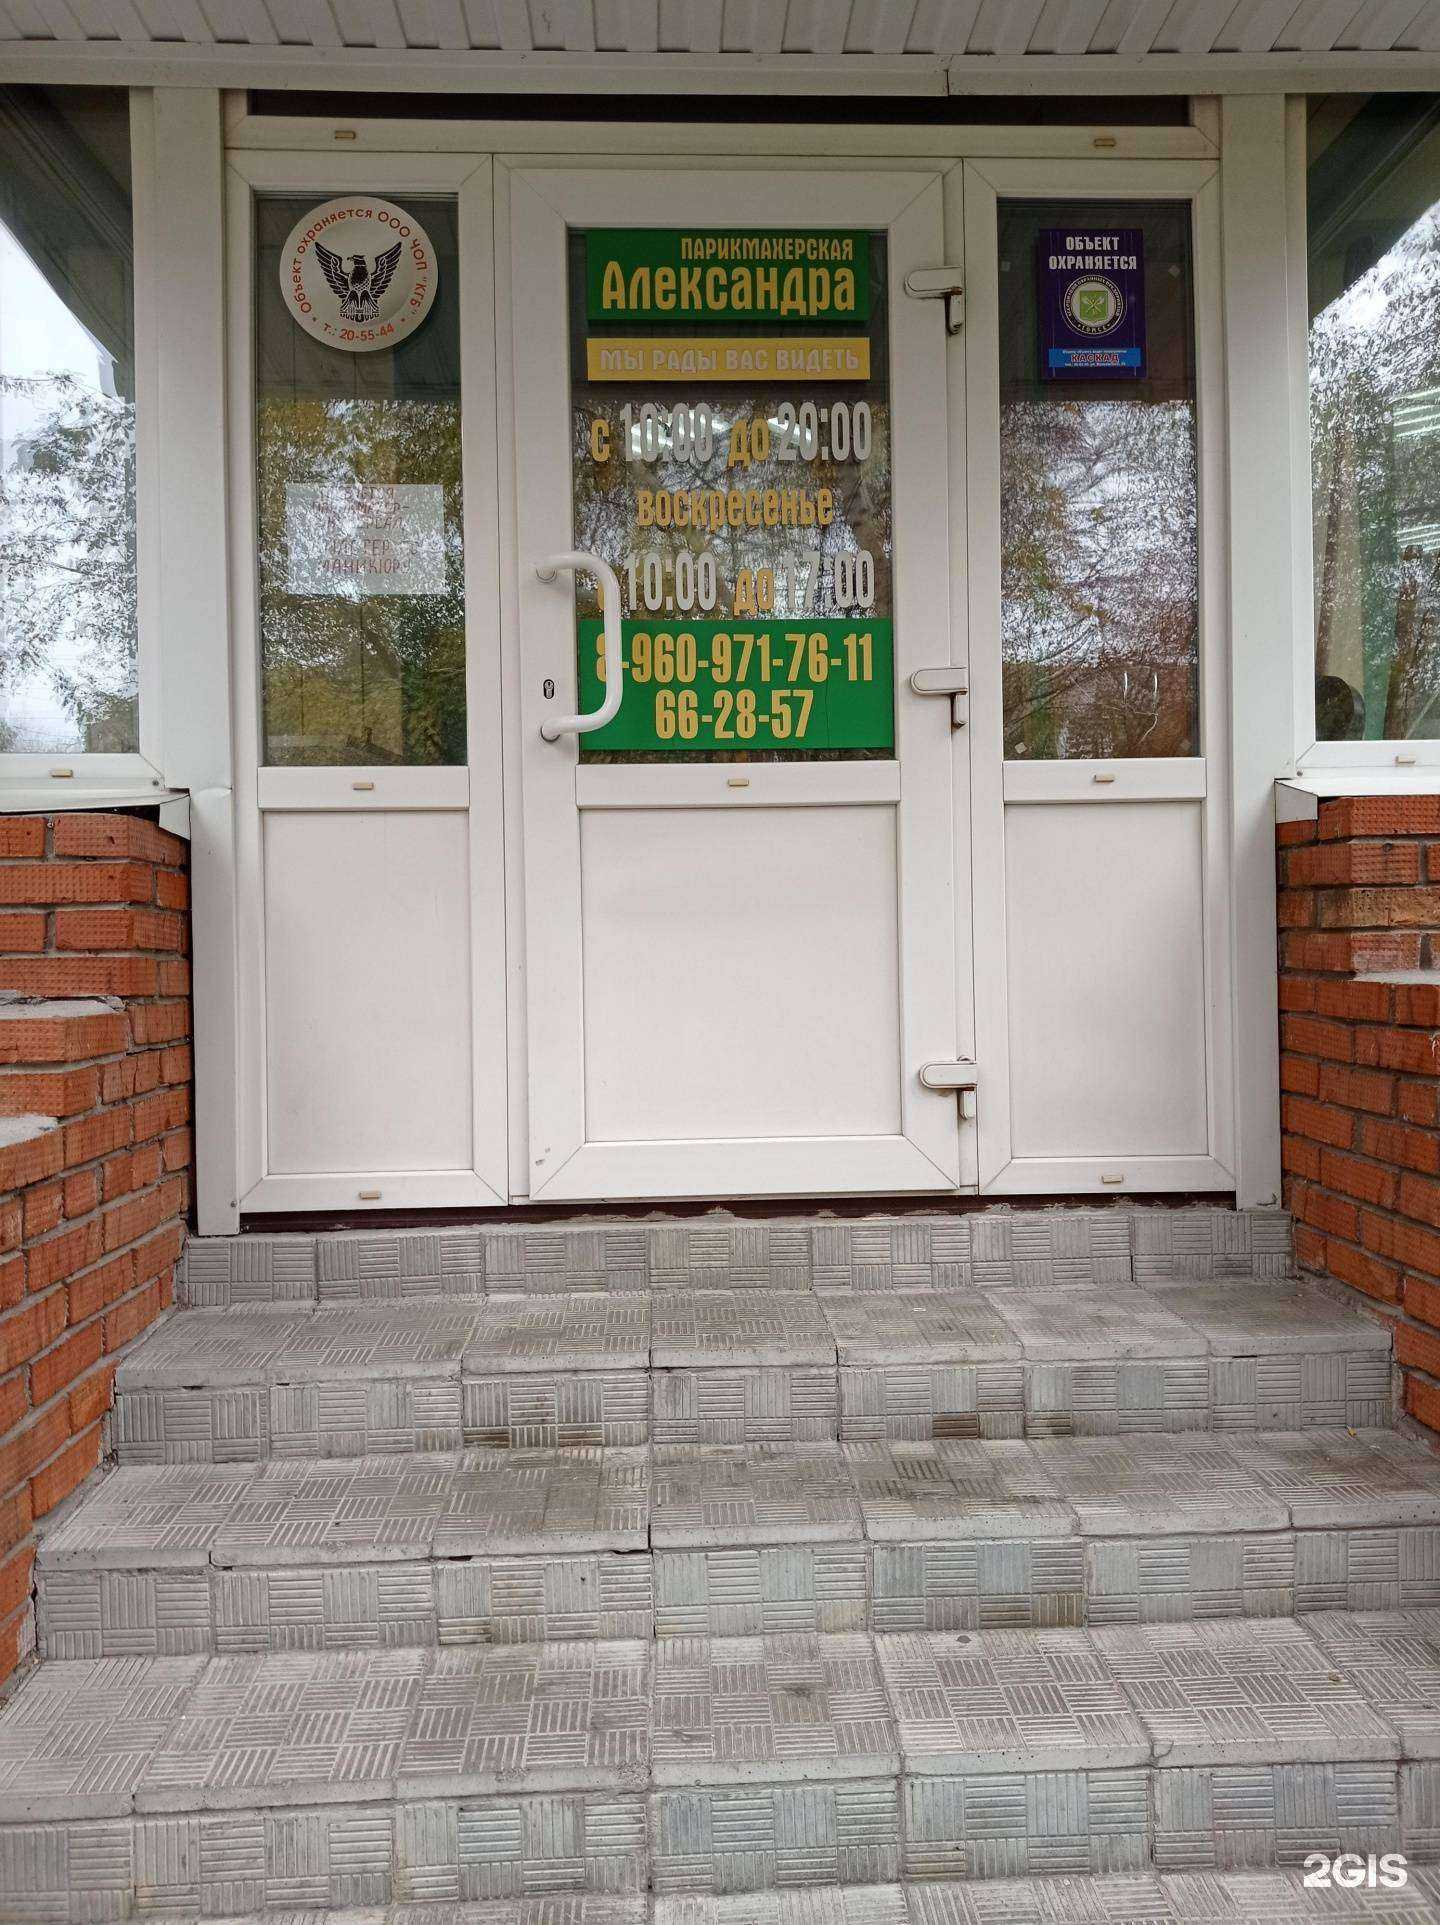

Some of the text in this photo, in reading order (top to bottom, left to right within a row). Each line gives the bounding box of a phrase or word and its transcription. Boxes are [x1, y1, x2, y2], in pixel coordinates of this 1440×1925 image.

[297, 208, 373, 254] охраняется
[378, 211, 411, 237] ООО
[411, 239, 427, 270] ЧОП
[681, 238, 853, 260] ПАРИКМАХЕРСКАЯ
[1066, 236, 1120, 250] ОБЪЕКТ
[1049, 255, 1137, 270] ОХРАНЯЕТСЯ
[292, 258, 312, 313] Объект
[602, 260, 855, 316] Александра
[339, 322, 395, 341] 20-55-44
[600, 350, 859, 373] МЫ РАДЫ ВАС ВИДЕТЬ
[619, 402, 713, 462] 10:00
[777, 402, 872, 462] 20:00
[637, 488, 834, 532] воскресенье
[624, 551, 717, 611] 10:00
[655, 689, 814, 739] 66-28-57
